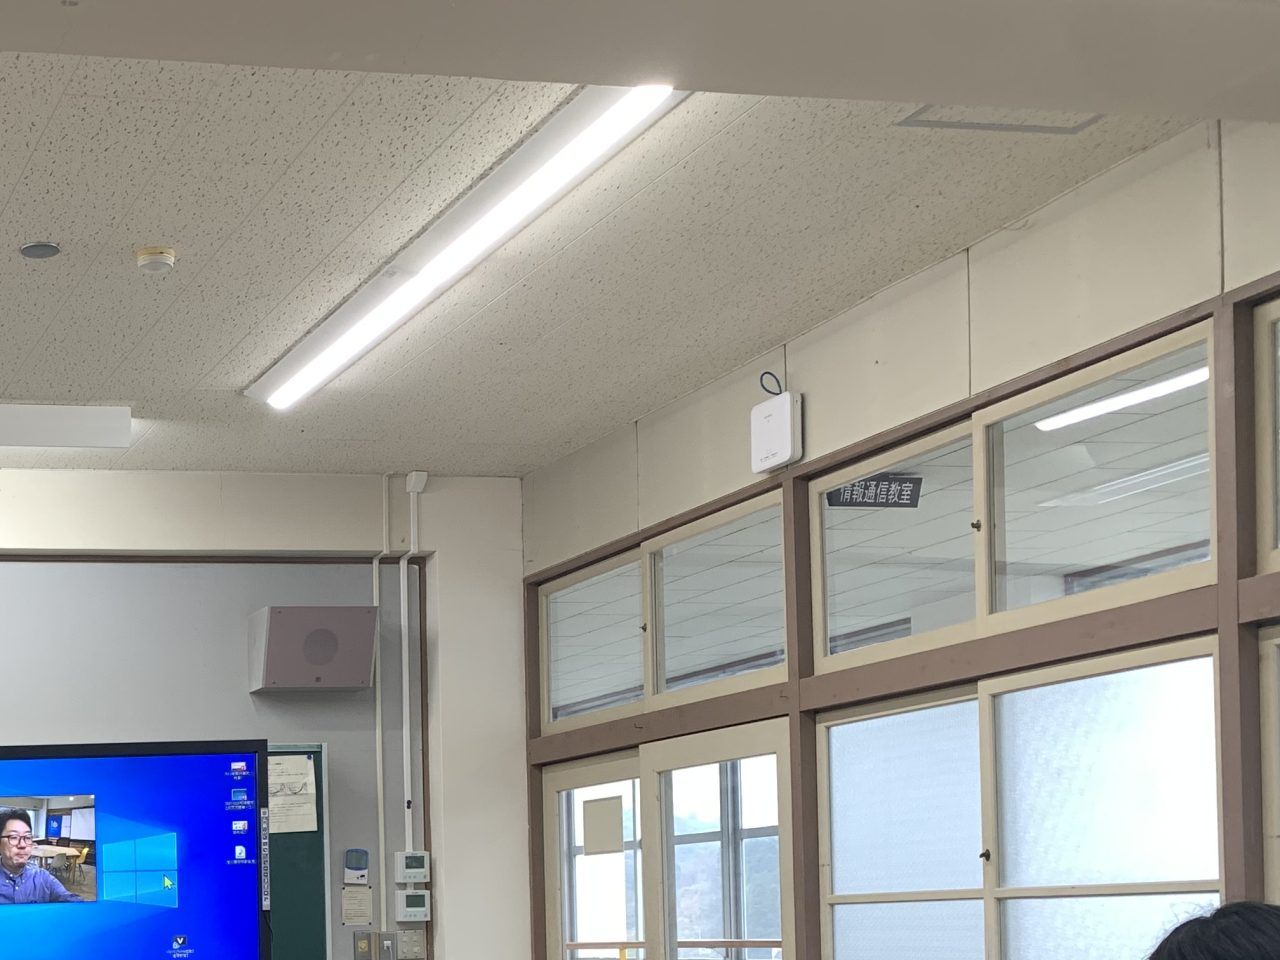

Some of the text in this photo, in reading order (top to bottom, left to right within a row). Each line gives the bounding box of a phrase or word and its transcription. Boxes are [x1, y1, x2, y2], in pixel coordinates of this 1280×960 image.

[840, 481, 913, 503] 情報通信教室
